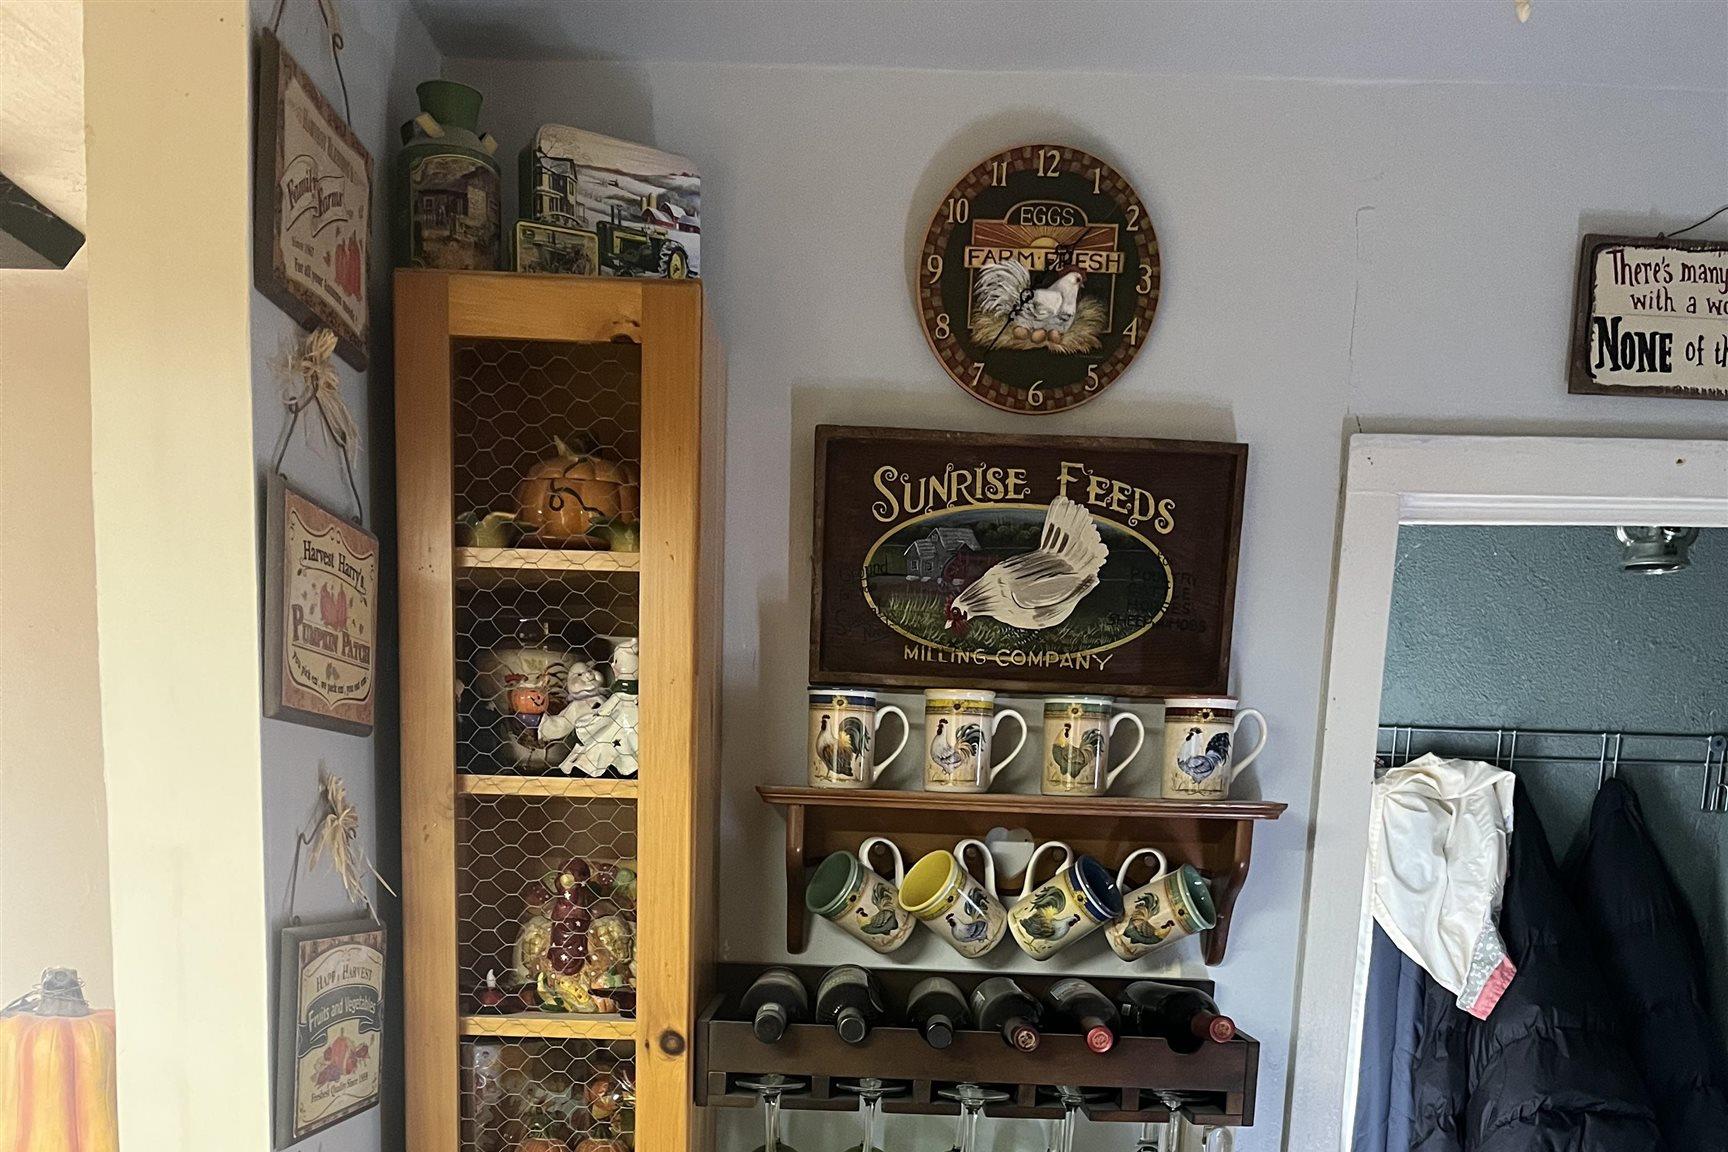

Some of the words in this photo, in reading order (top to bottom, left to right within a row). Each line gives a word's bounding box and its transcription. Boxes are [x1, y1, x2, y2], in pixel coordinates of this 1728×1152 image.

[991, 161, 1008, 187] 11
[1037, 149, 1061, 178] 12
[1092, 168, 1101, 194] 1
[947, 198, 969, 224] 10
[1020, 206, 1075, 227] EGGS
[1125, 204, 1140, 232] 2
[926, 254, 944, 284] 9
[1136, 264, 1153, 294] 3
[1605, 249, 1674, 287] There's
[1679, 262, 1728, 295] many
[1630, 286, 1677, 313] with
[1686, 296, 1697, 315] a
[934, 313, 951, 339] 8
[1122, 316, 1139, 345] 4
[1592, 315, 1674, 373] NONE
[1685, 334, 1705, 366] of
[972, 362, 985, 387] 7
[1084, 364, 1100, 391] 5
[1027, 380, 1044, 407] 6
[872, 461, 1032, 523] SUNRISE
[1056, 461, 1176, 535] FEEDS
[303, 539, 335, 569] Harvest
[338, 552, 365, 590] Harry's
[292, 603, 339, 655] PUMPKIN
[342, 630, 371, 665] PATCH
[903, 644, 987, 665] MILLING
[996, 648, 1114, 671] COMPANY
[342, 964, 373, 981] HARVEST
[308, 1007, 330, 1033] Fruits
[330, 997, 344, 1018] and
